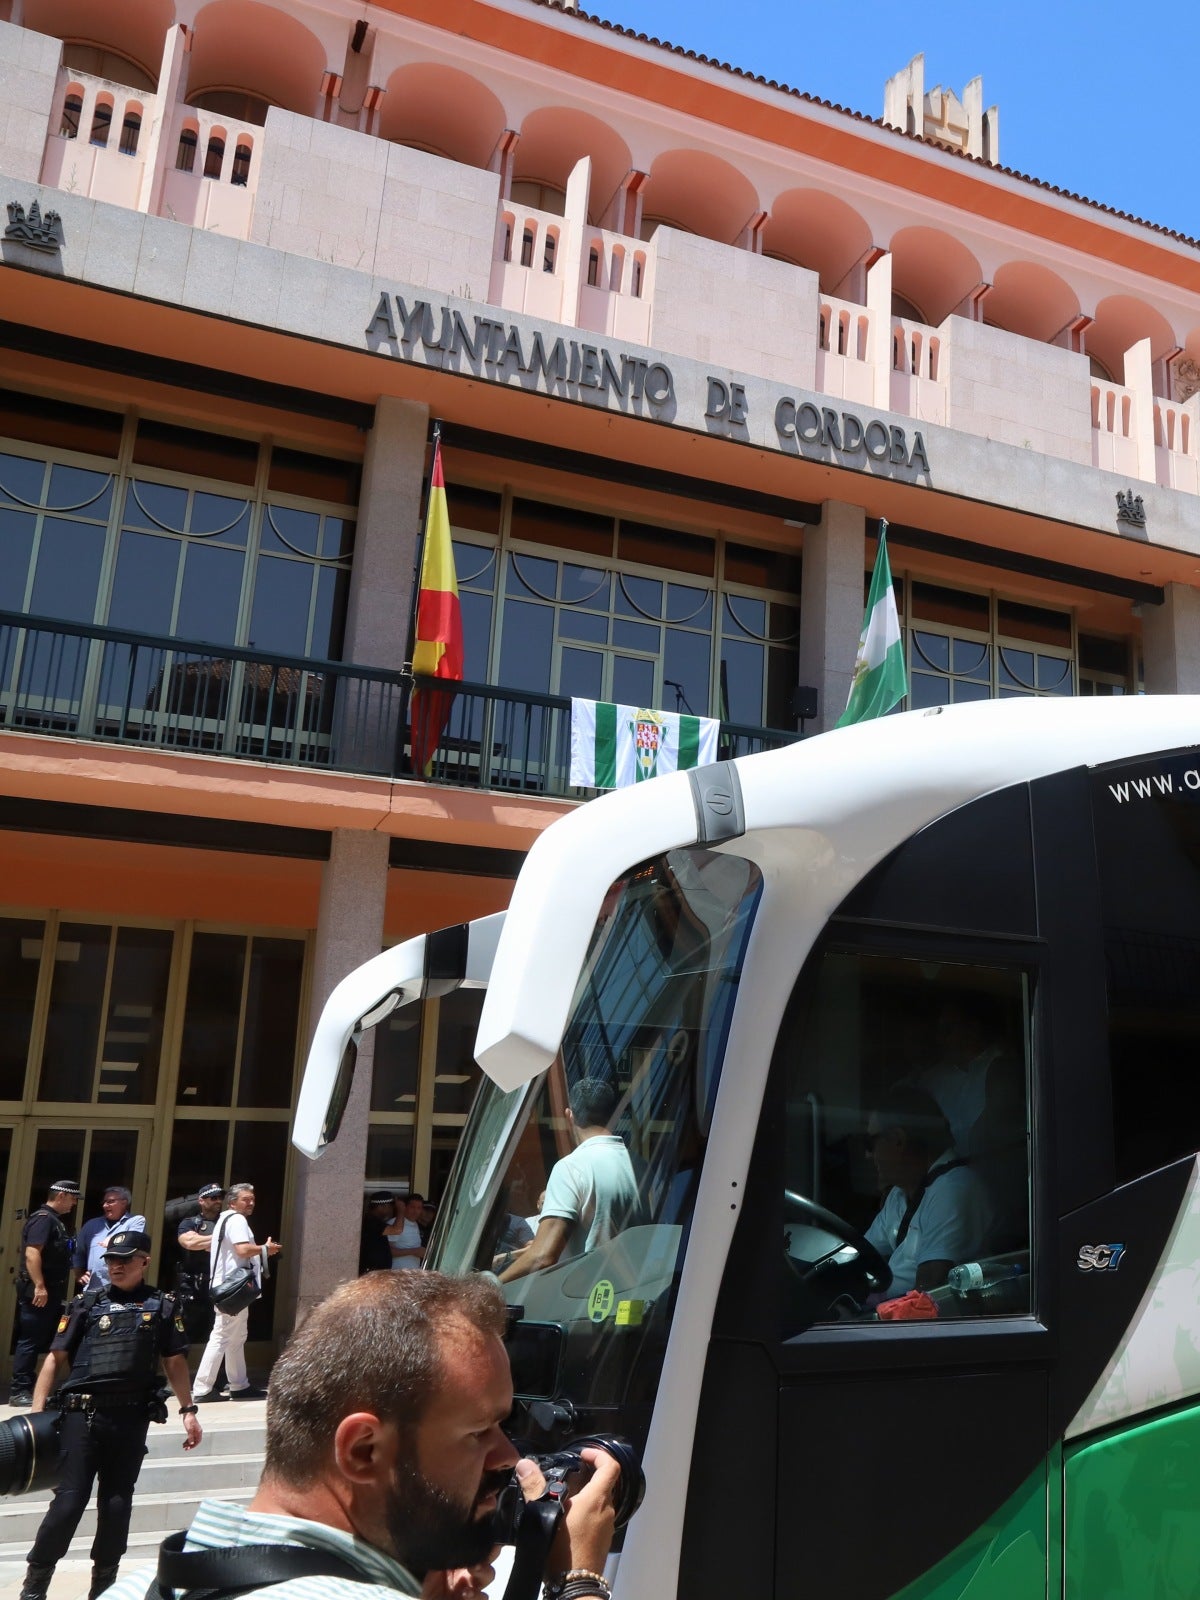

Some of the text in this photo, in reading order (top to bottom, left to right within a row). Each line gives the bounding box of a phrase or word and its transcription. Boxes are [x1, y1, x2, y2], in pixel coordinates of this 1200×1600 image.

[366, 291, 931, 473] AYUNTAMIENTO DE CORDOBA
[1076, 1243, 1127, 1272] SC7
